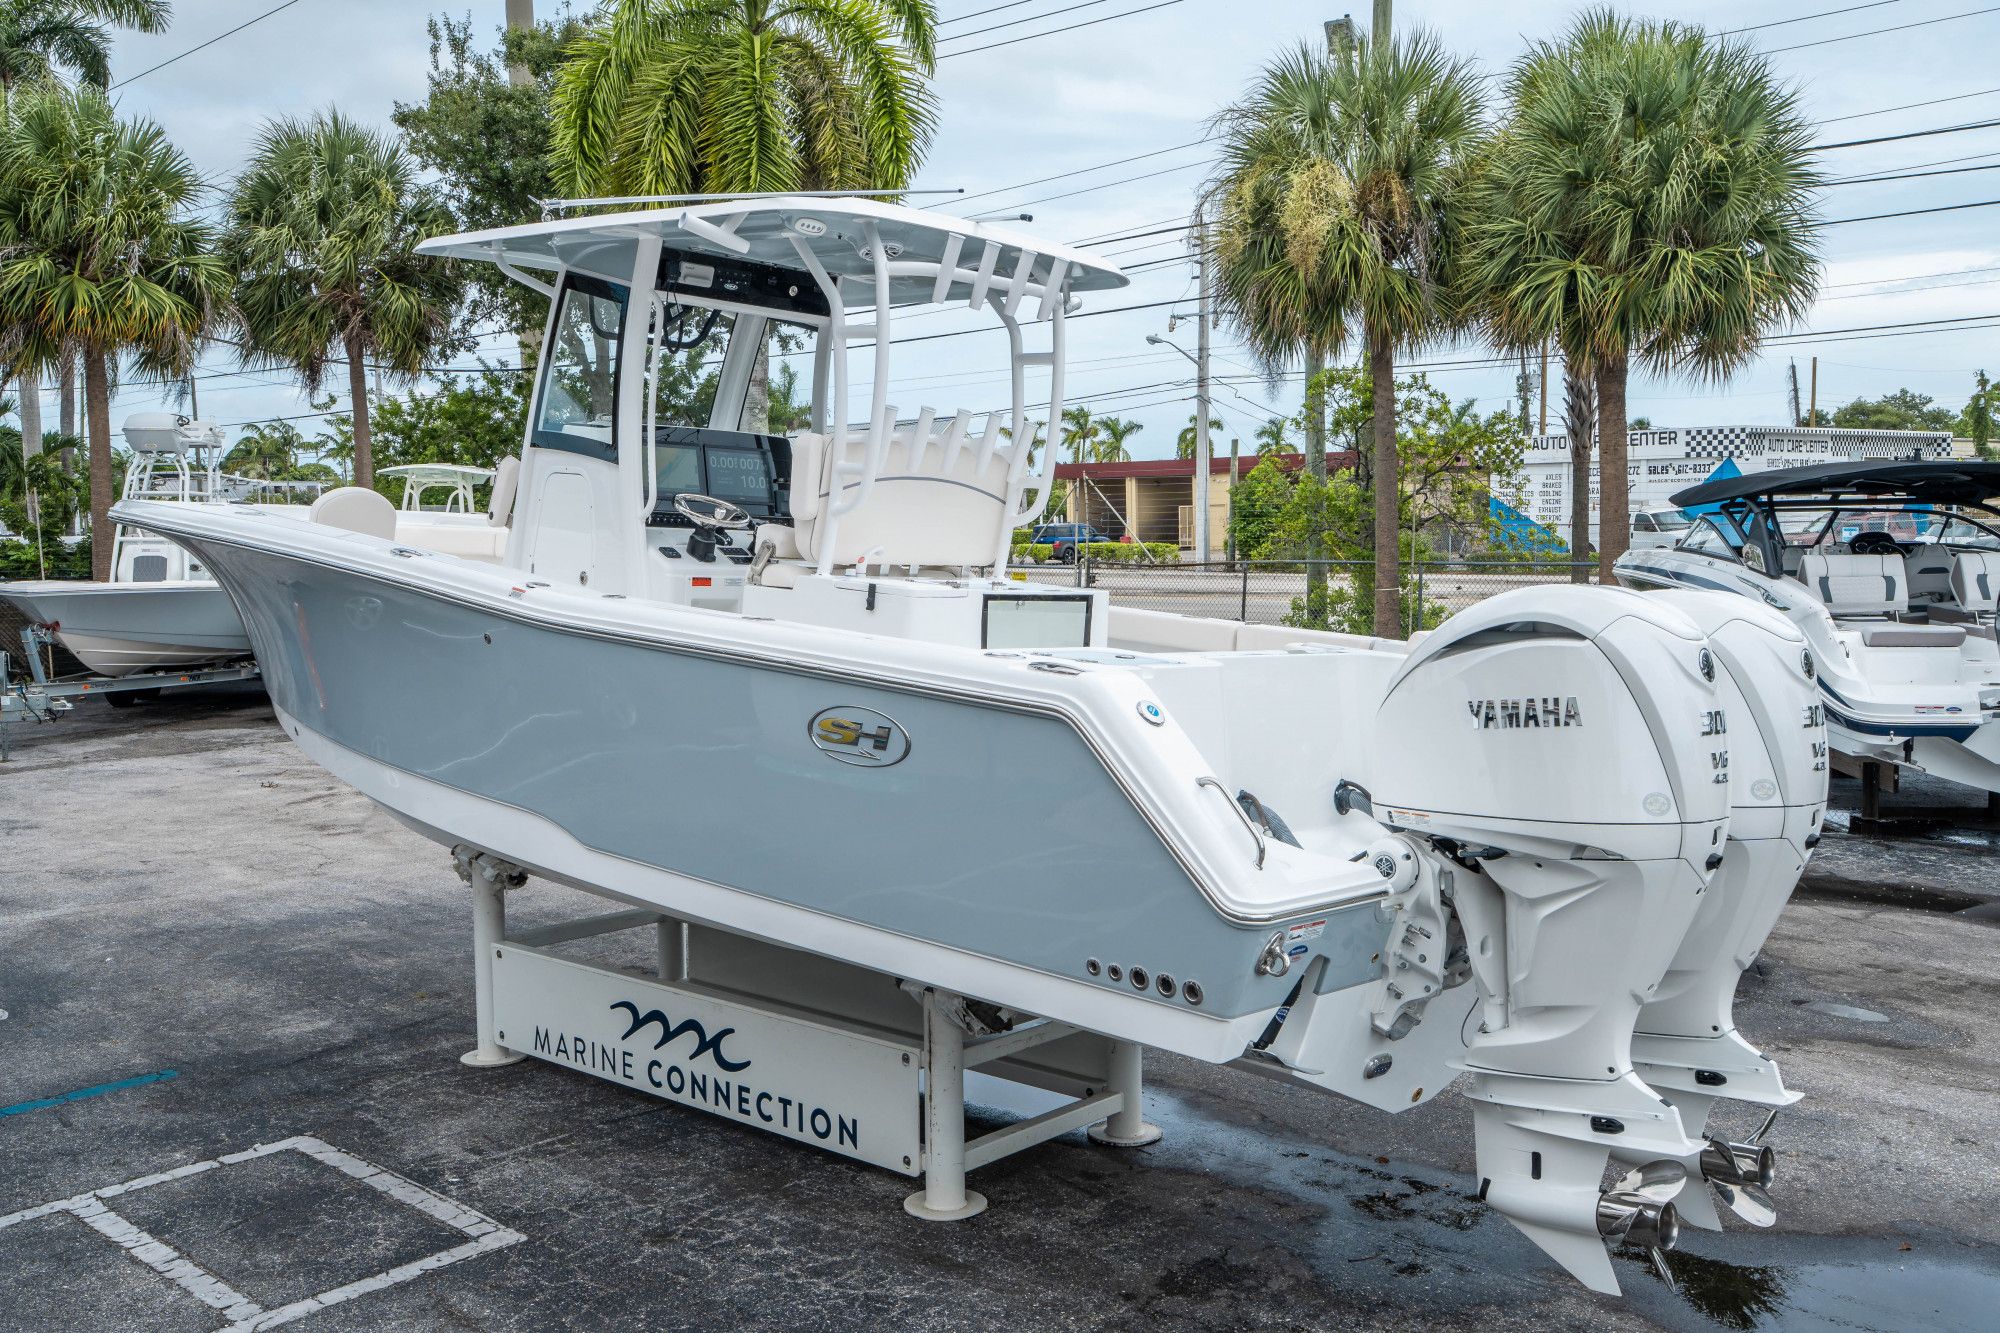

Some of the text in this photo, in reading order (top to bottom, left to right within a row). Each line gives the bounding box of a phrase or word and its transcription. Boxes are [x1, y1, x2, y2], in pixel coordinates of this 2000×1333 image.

[1532, 436, 1567, 451] AUTO
[1768, 439, 1784, 452] AUTO
[1787, 439, 1803, 453] CARE
[1468, 696, 1582, 729] YAMAHA
[533, 1025, 858, 1150] MARINE CONNECTION
